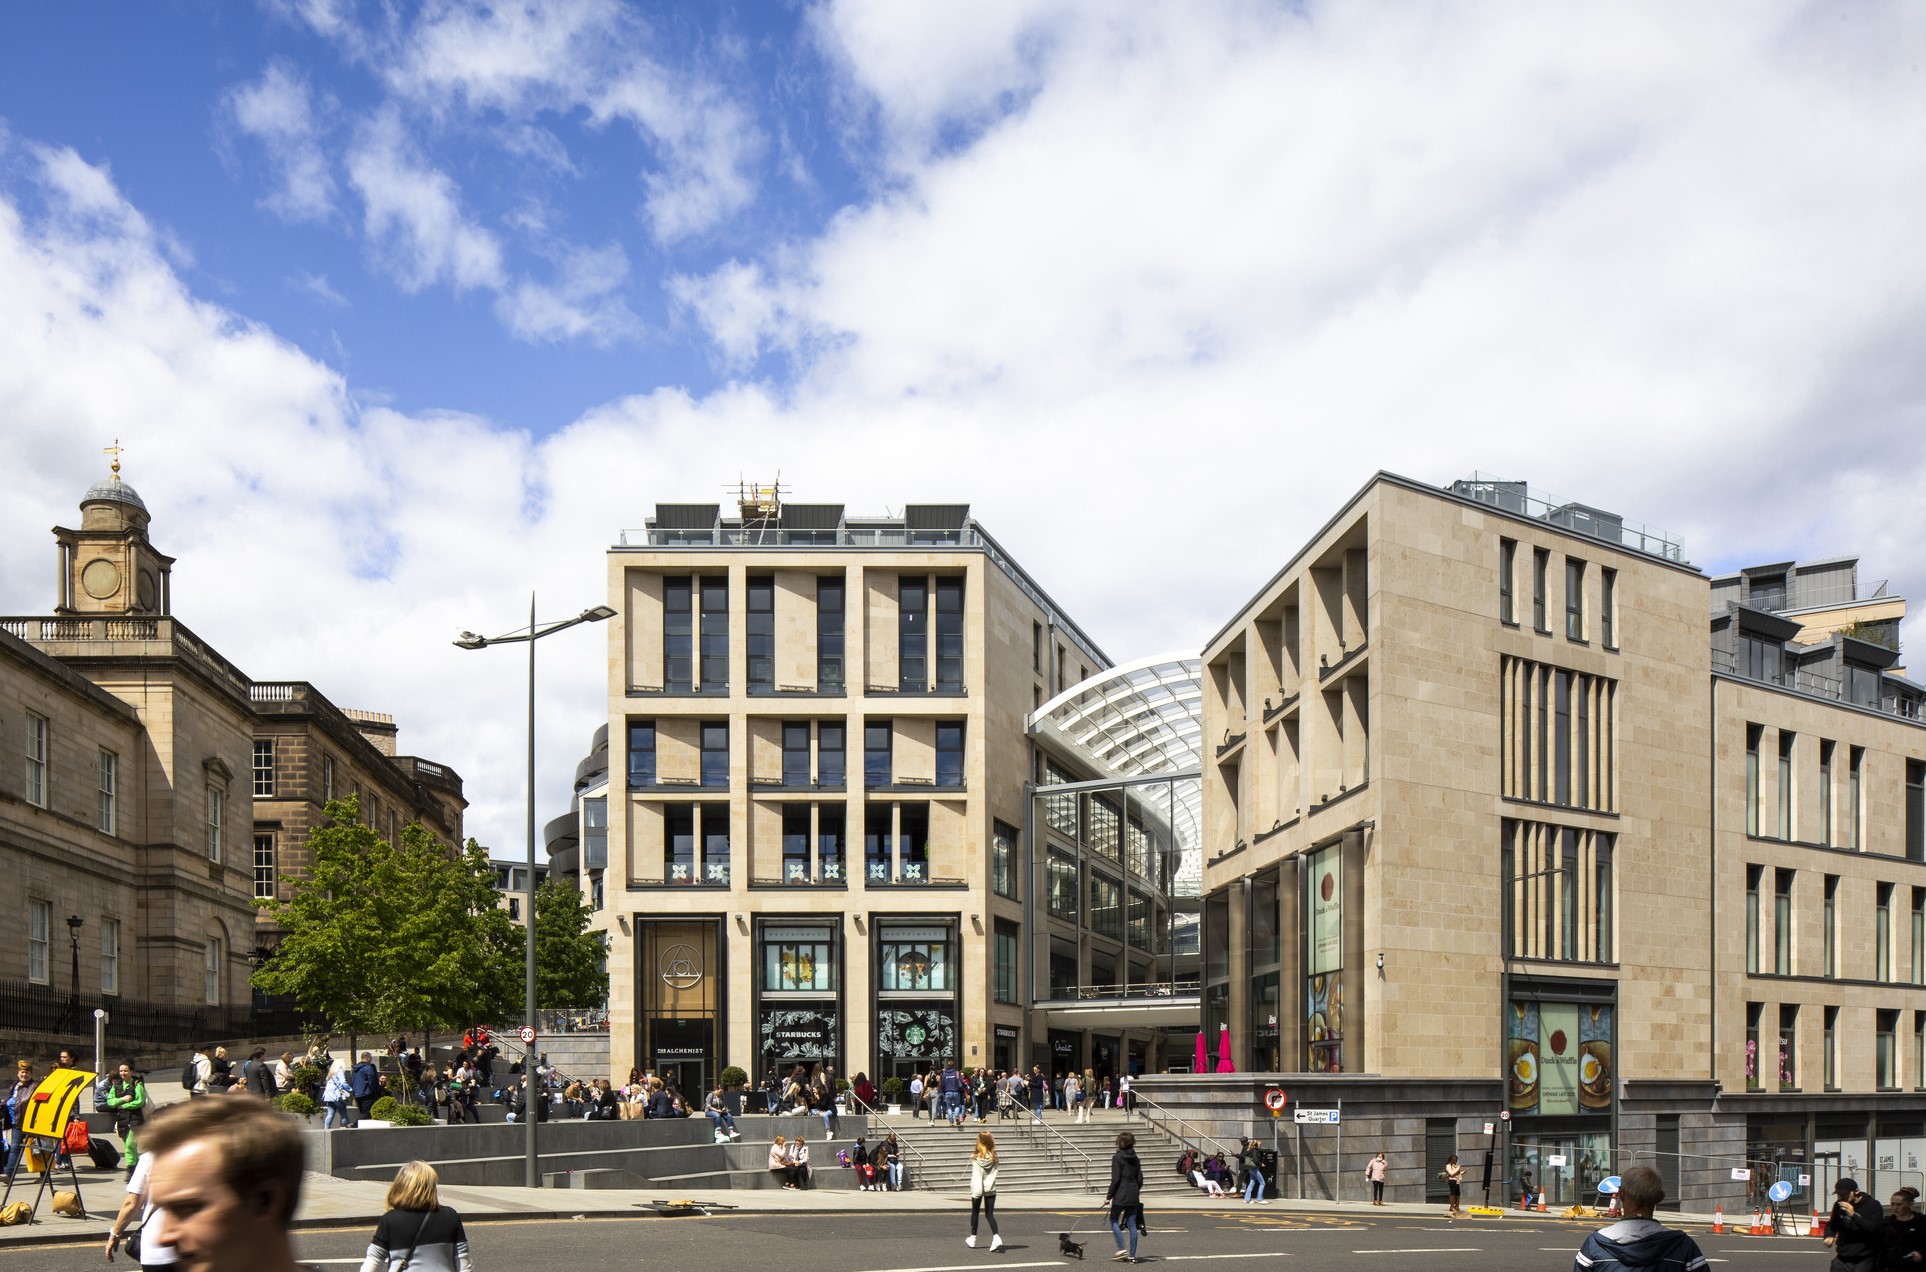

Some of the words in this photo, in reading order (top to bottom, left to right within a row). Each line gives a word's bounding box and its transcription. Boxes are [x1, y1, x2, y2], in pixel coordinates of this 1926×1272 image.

[522, 1031, 534, 1039] 20
[996, 1028, 1017, 1038] STARBUCKS
[1540, 1056, 1555, 1065] Duck
[1560, 1056, 1577, 1065] Waffle
